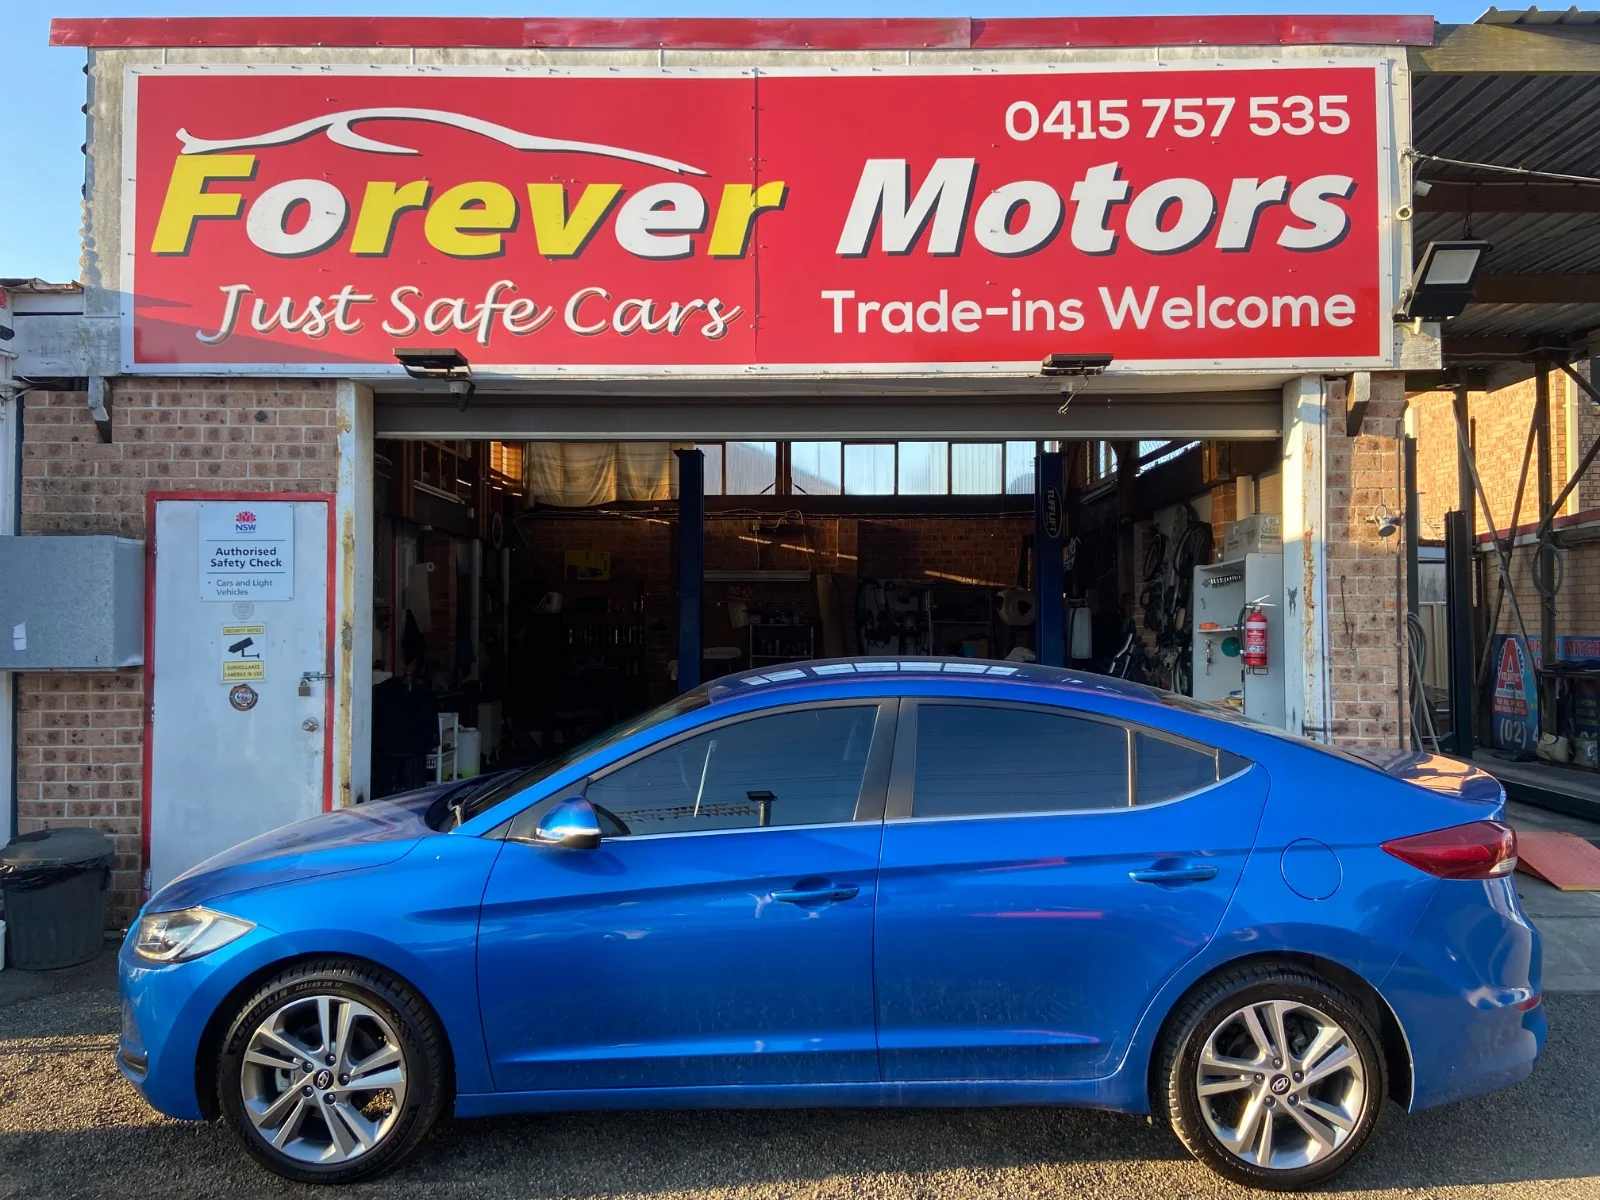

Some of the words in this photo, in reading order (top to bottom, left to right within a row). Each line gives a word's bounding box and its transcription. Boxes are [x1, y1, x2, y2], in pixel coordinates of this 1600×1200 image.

[1006, 99, 1130, 142] 0415
[1142, 98, 1236, 138] 757
[1249, 95, 1351, 136] 535
[150, 154, 787, 257] Forever
[836, 157, 1356, 256] Motors
[196, 284, 376, 345] Just
[382, 280, 554, 345] Safe
[564, 286, 742, 339] Cars
[821, 289, 1085, 335] Trade-ins
[1097, 285, 1356, 331] Welcome
[235, 523, 257, 531] NSW
[210, 558, 246, 569] Safety
[249, 558, 282, 567] Check
[215, 547, 277, 556] Authorised
[216, 579, 234, 587] Cars
[235, 579, 251, 587] and
[252, 579, 273, 588] Light
[216, 588, 249, 596] Vehicles
[1499, 718, 1527, 749] (02)
[237, 988, 288, 1038] MICHELIN
